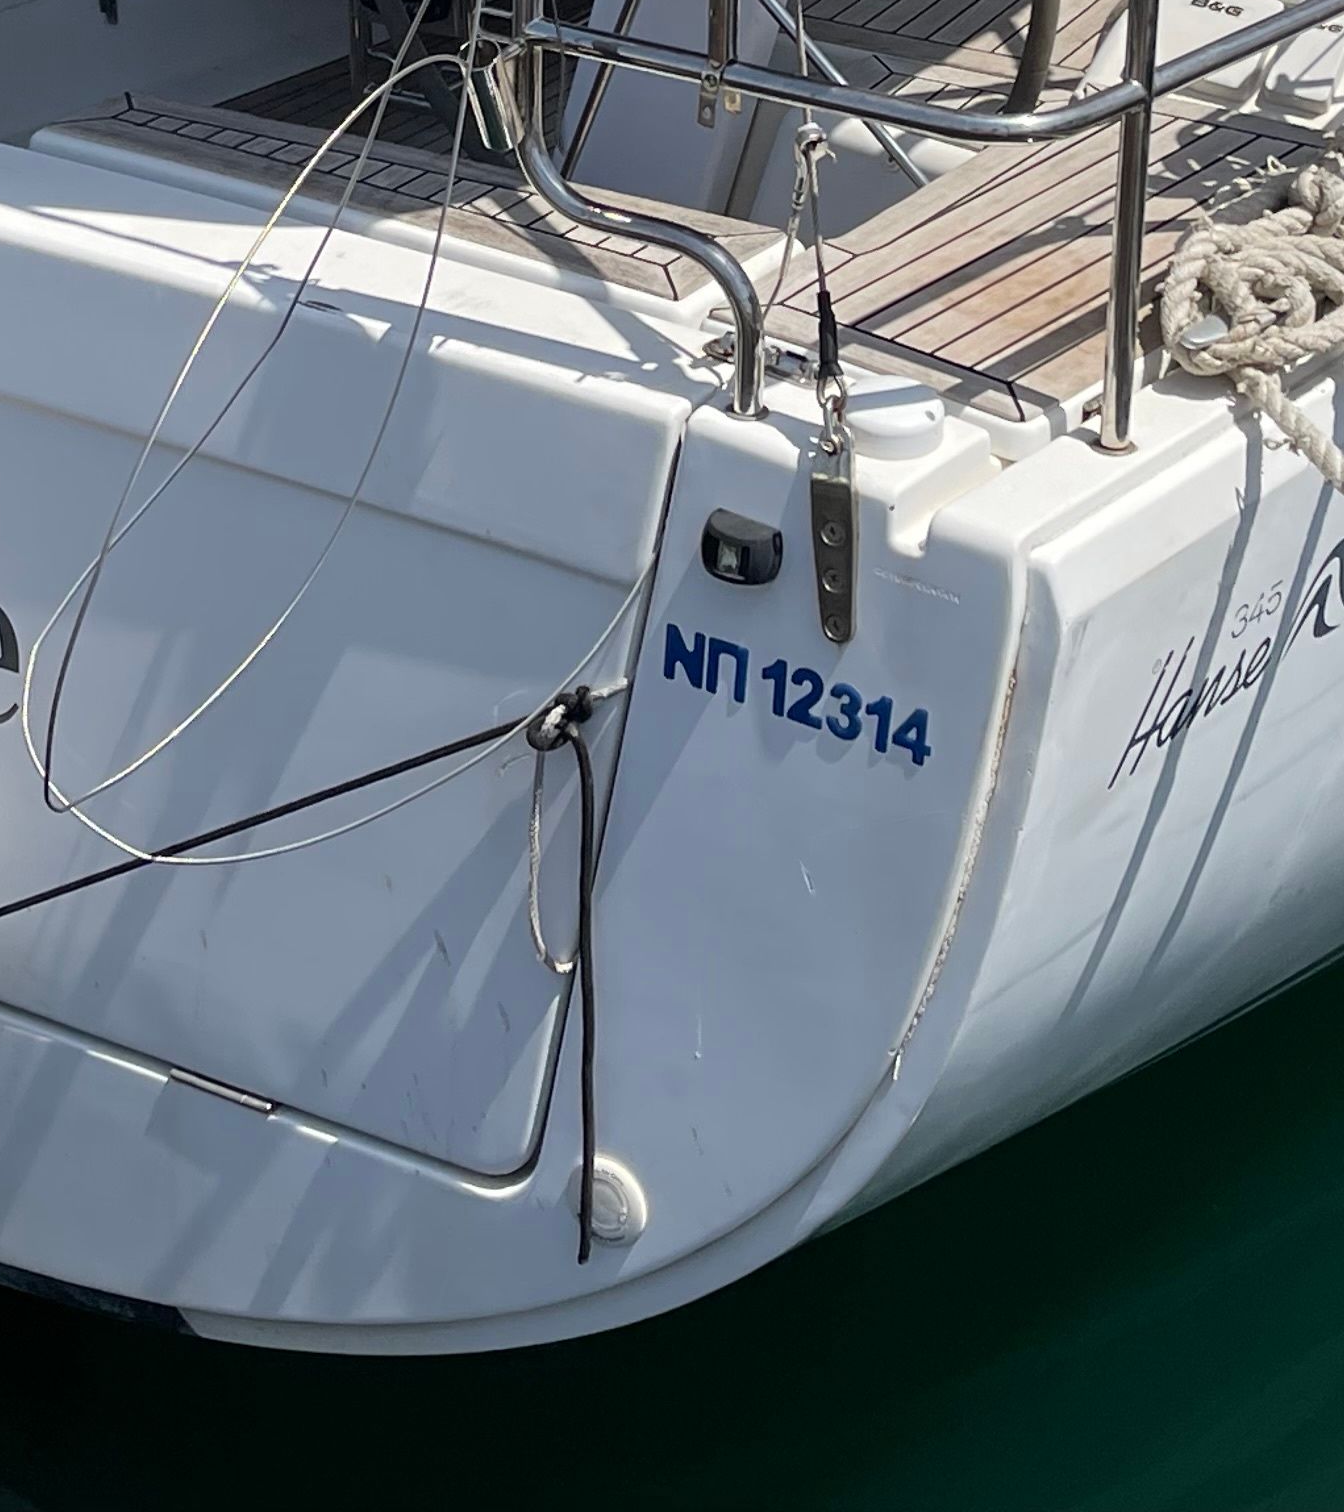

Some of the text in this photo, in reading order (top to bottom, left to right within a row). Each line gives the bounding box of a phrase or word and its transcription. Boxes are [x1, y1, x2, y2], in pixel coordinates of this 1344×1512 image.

[1231, 579, 1283, 639] 345
[761, 658, 931, 766] 12314
[1107, 635, 1272, 790] Hanse
